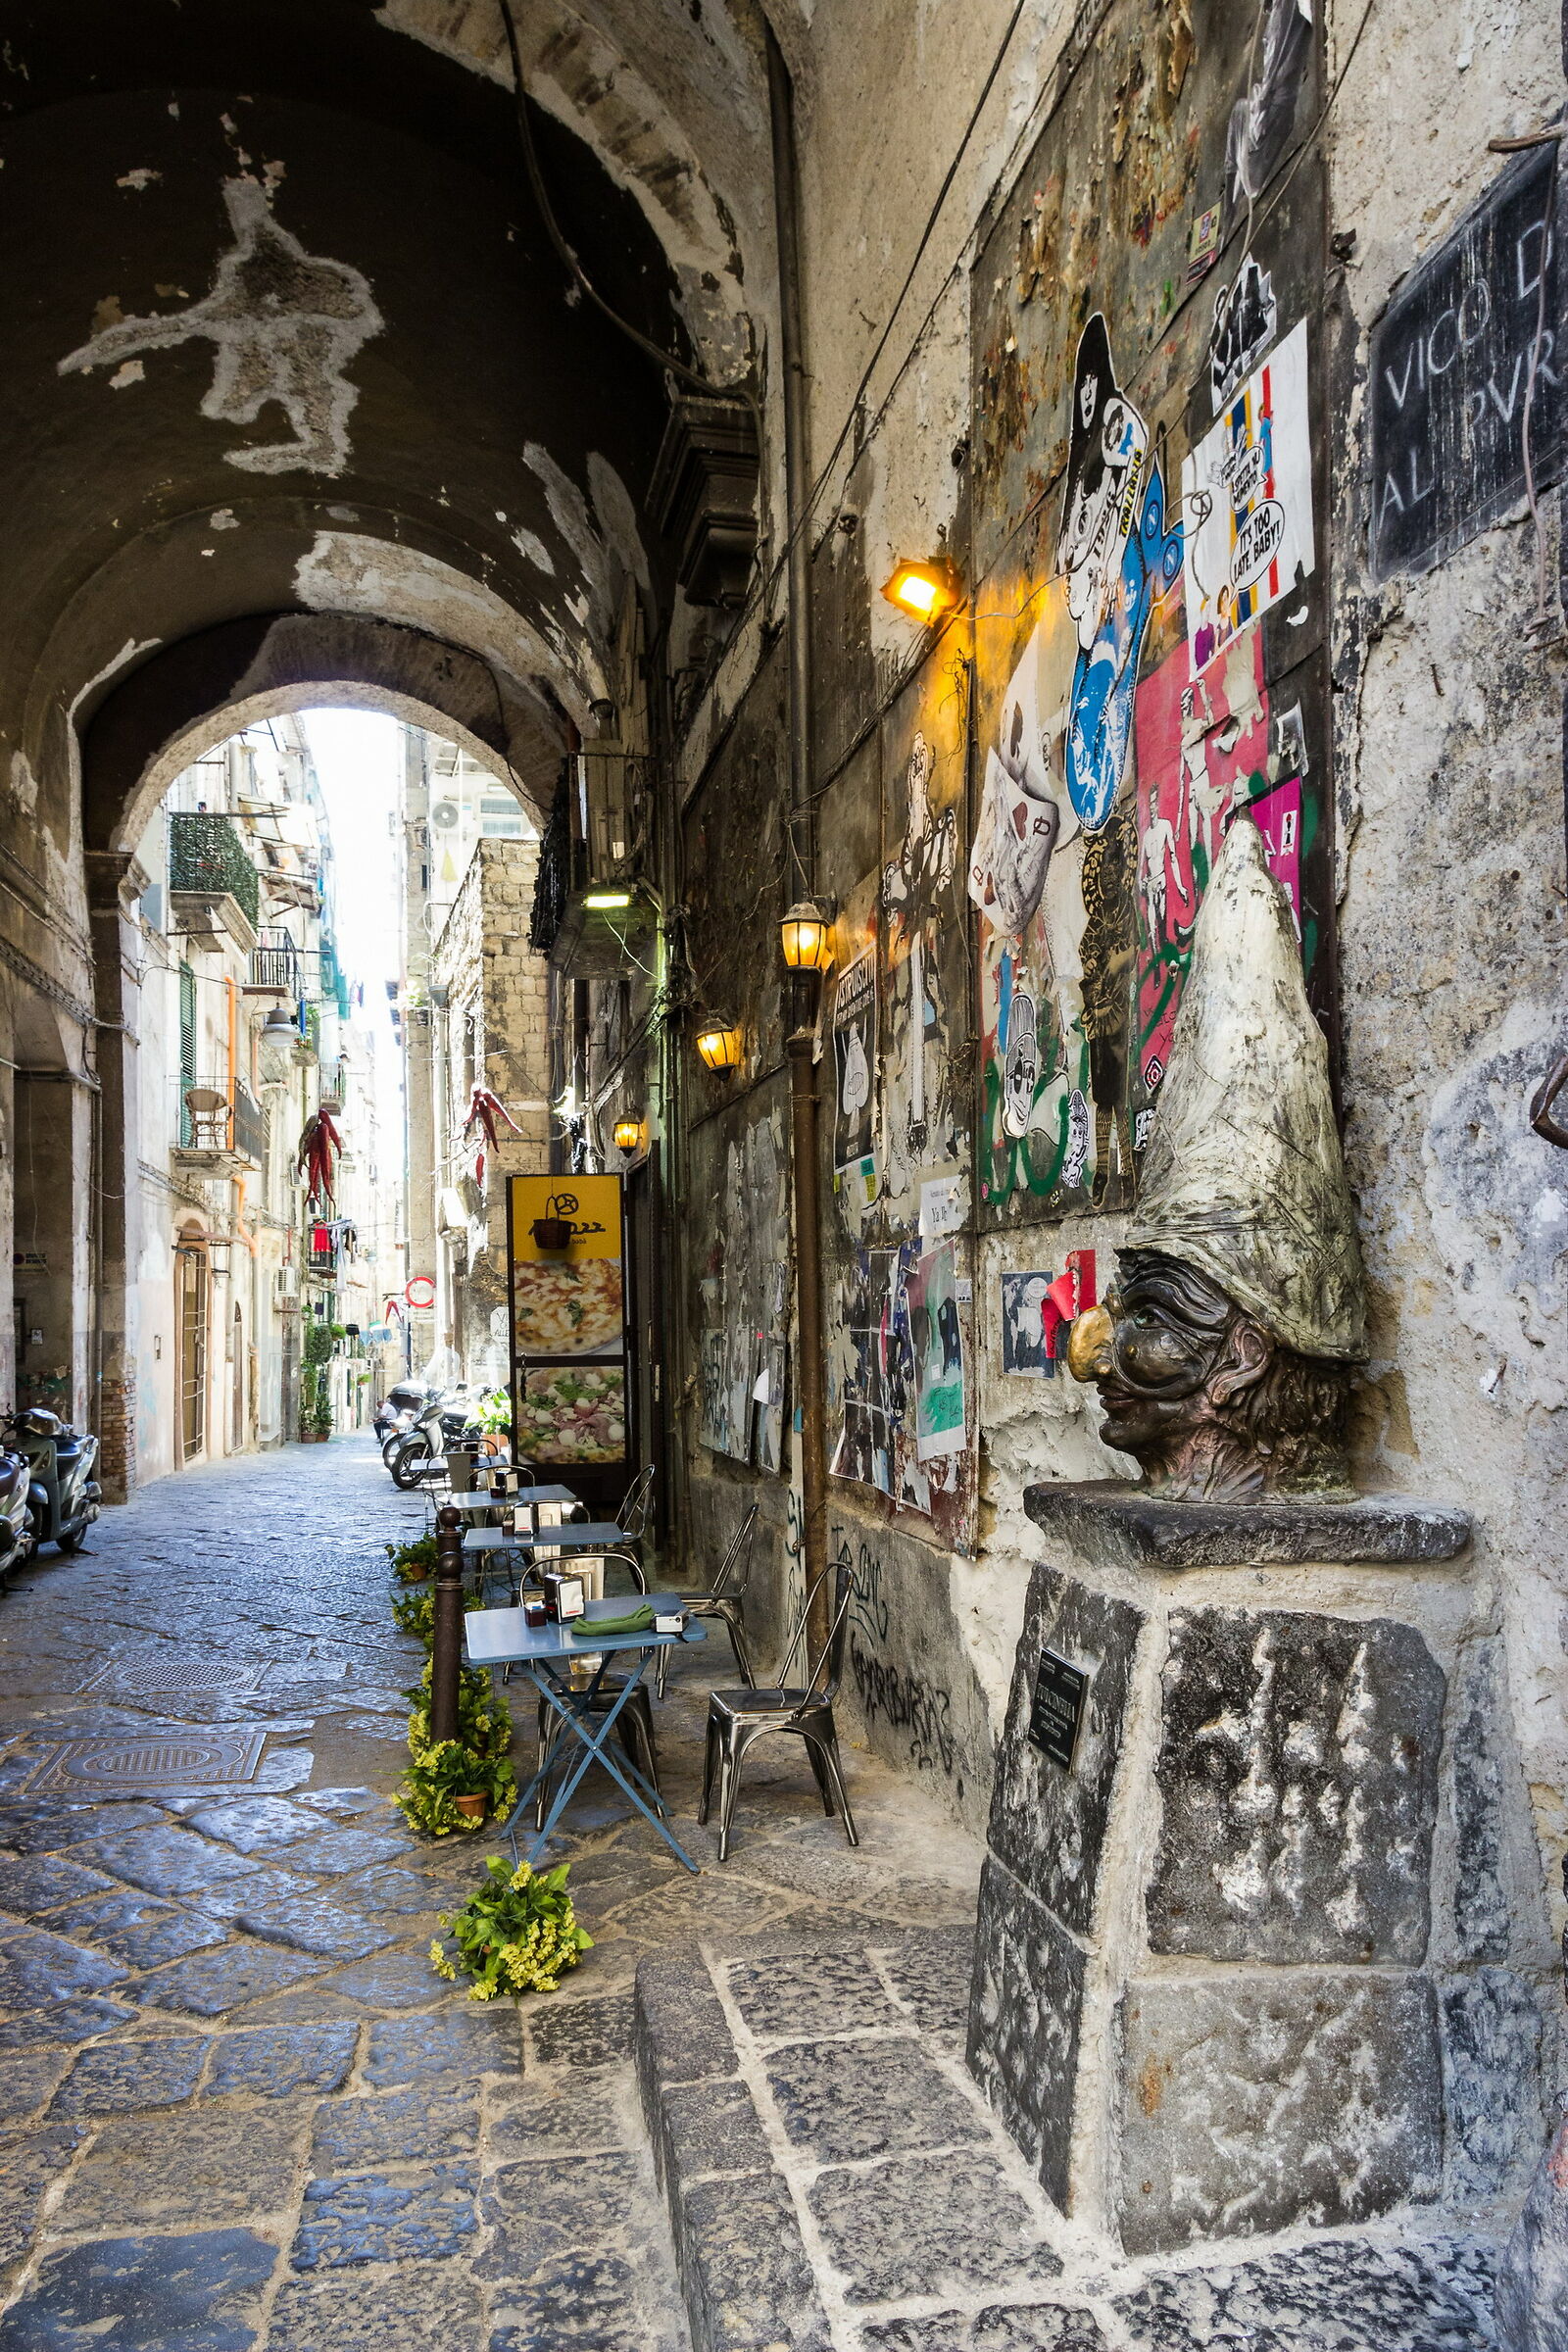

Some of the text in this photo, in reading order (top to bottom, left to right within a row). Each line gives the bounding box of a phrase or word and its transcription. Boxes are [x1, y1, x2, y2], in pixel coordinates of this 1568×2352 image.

[1385, 278, 1492, 410] VICO
[1376, 446, 1435, 537] AL
[1240, 507, 1271, 555] IT'S TOO
[1253, 519, 1281, 564] BABY!
